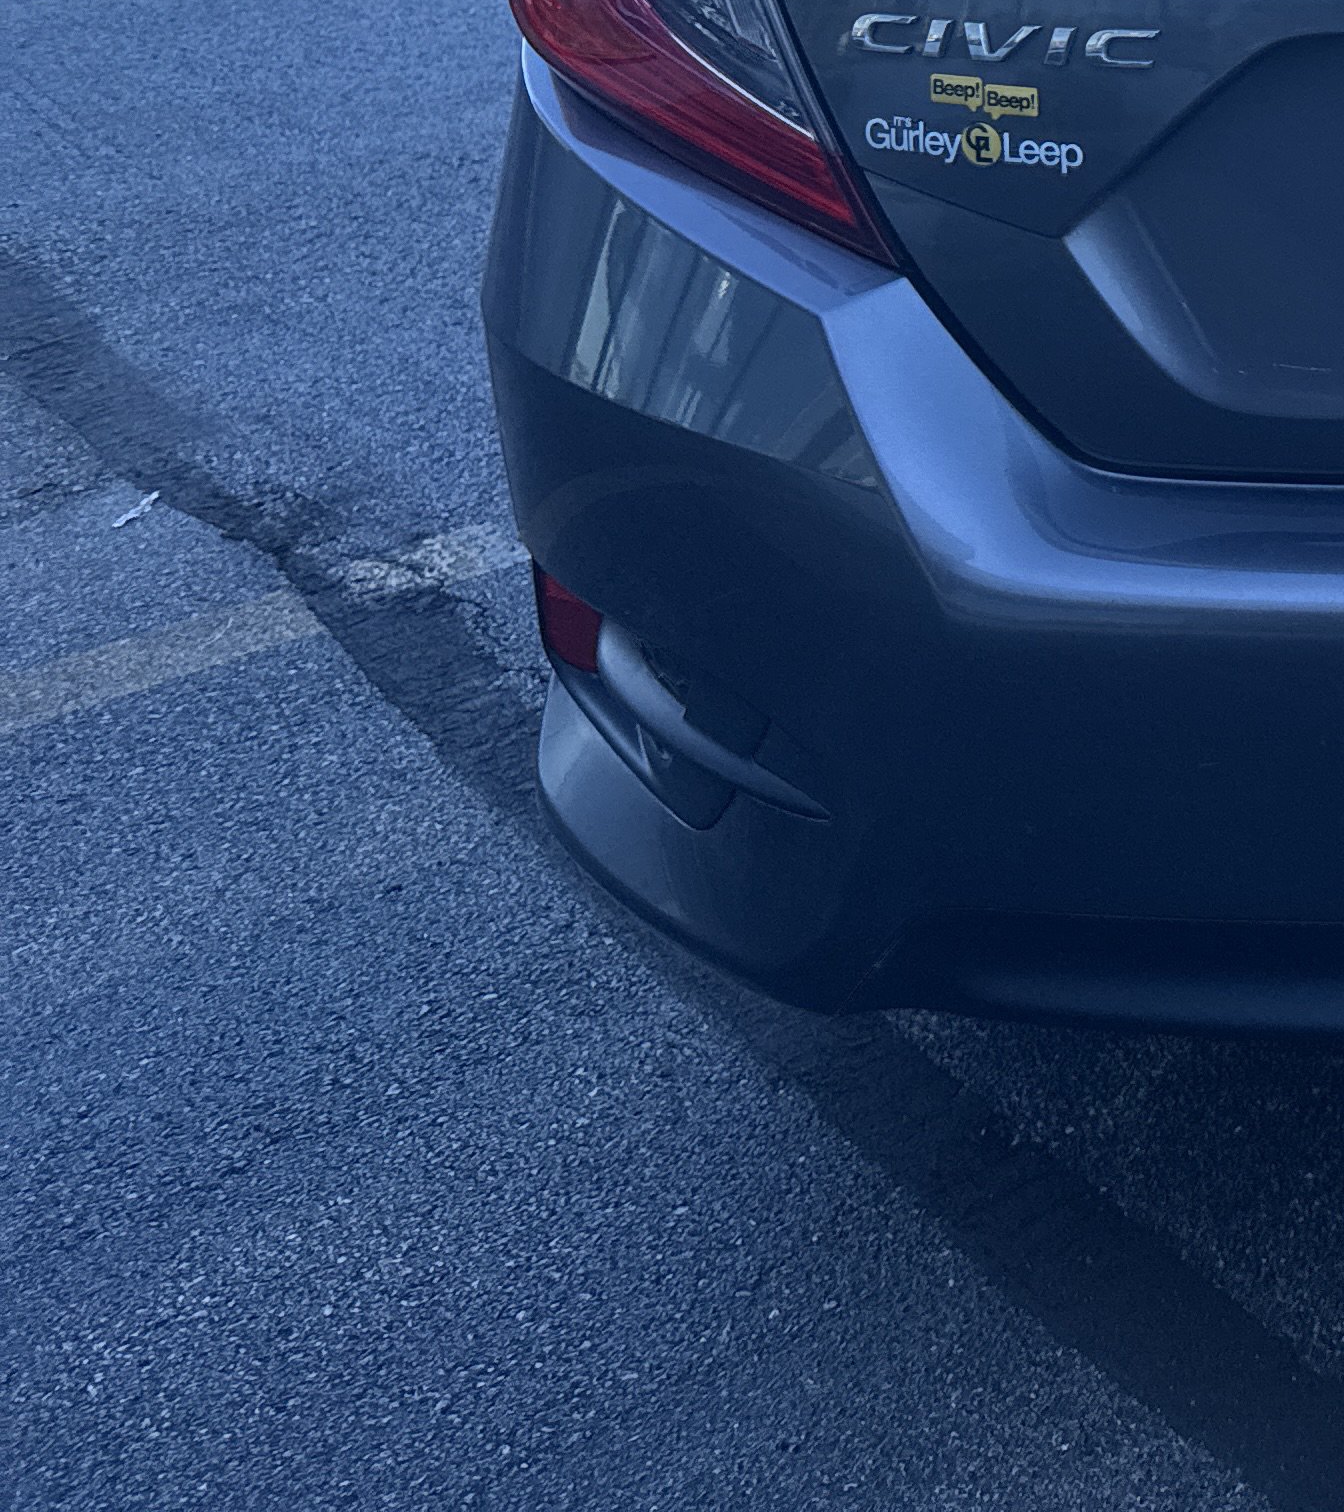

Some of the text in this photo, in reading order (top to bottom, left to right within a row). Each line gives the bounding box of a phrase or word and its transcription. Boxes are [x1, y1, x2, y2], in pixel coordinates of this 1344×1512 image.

[852, 13, 1161, 69] CIVIC
[932, 78, 1036, 111] Beep! Beep!
[865, 117, 962, 164] Gurley
[1003, 132, 1083, 174] Leep
